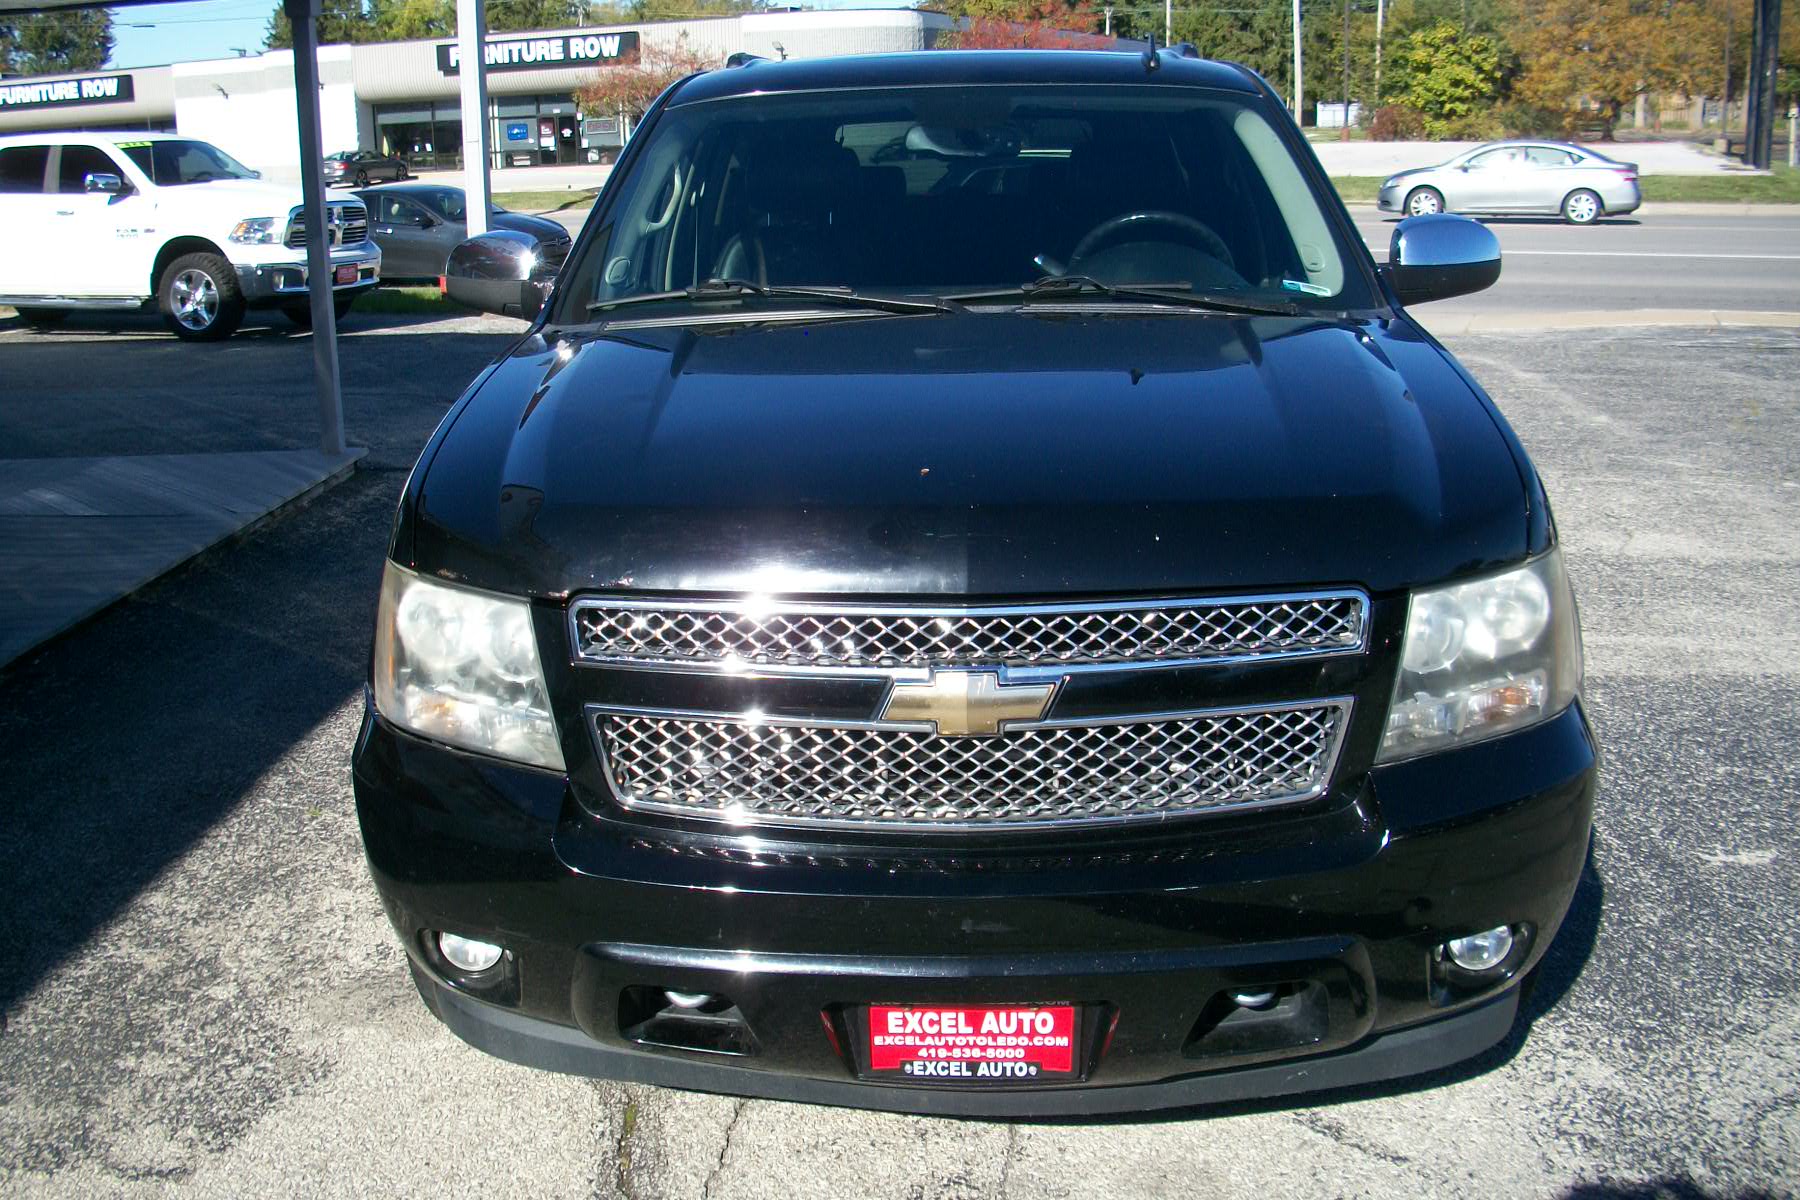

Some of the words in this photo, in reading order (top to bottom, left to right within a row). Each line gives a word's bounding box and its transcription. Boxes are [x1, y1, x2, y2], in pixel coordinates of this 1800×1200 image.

[449, 39, 565, 67] FNITURE
[569, 35, 620, 59] ROW
[81, 78, 118, 98] ROW
[887, 1011, 974, 1034] EXCEL
[980, 1011, 1055, 1034] AUTO
[873, 1035, 1069, 1047] EXCELAUTOTOLEDO.COM
[912, 1060, 973, 1077] EXCEL
[976, 1061, 1028, 1077] AUTO
